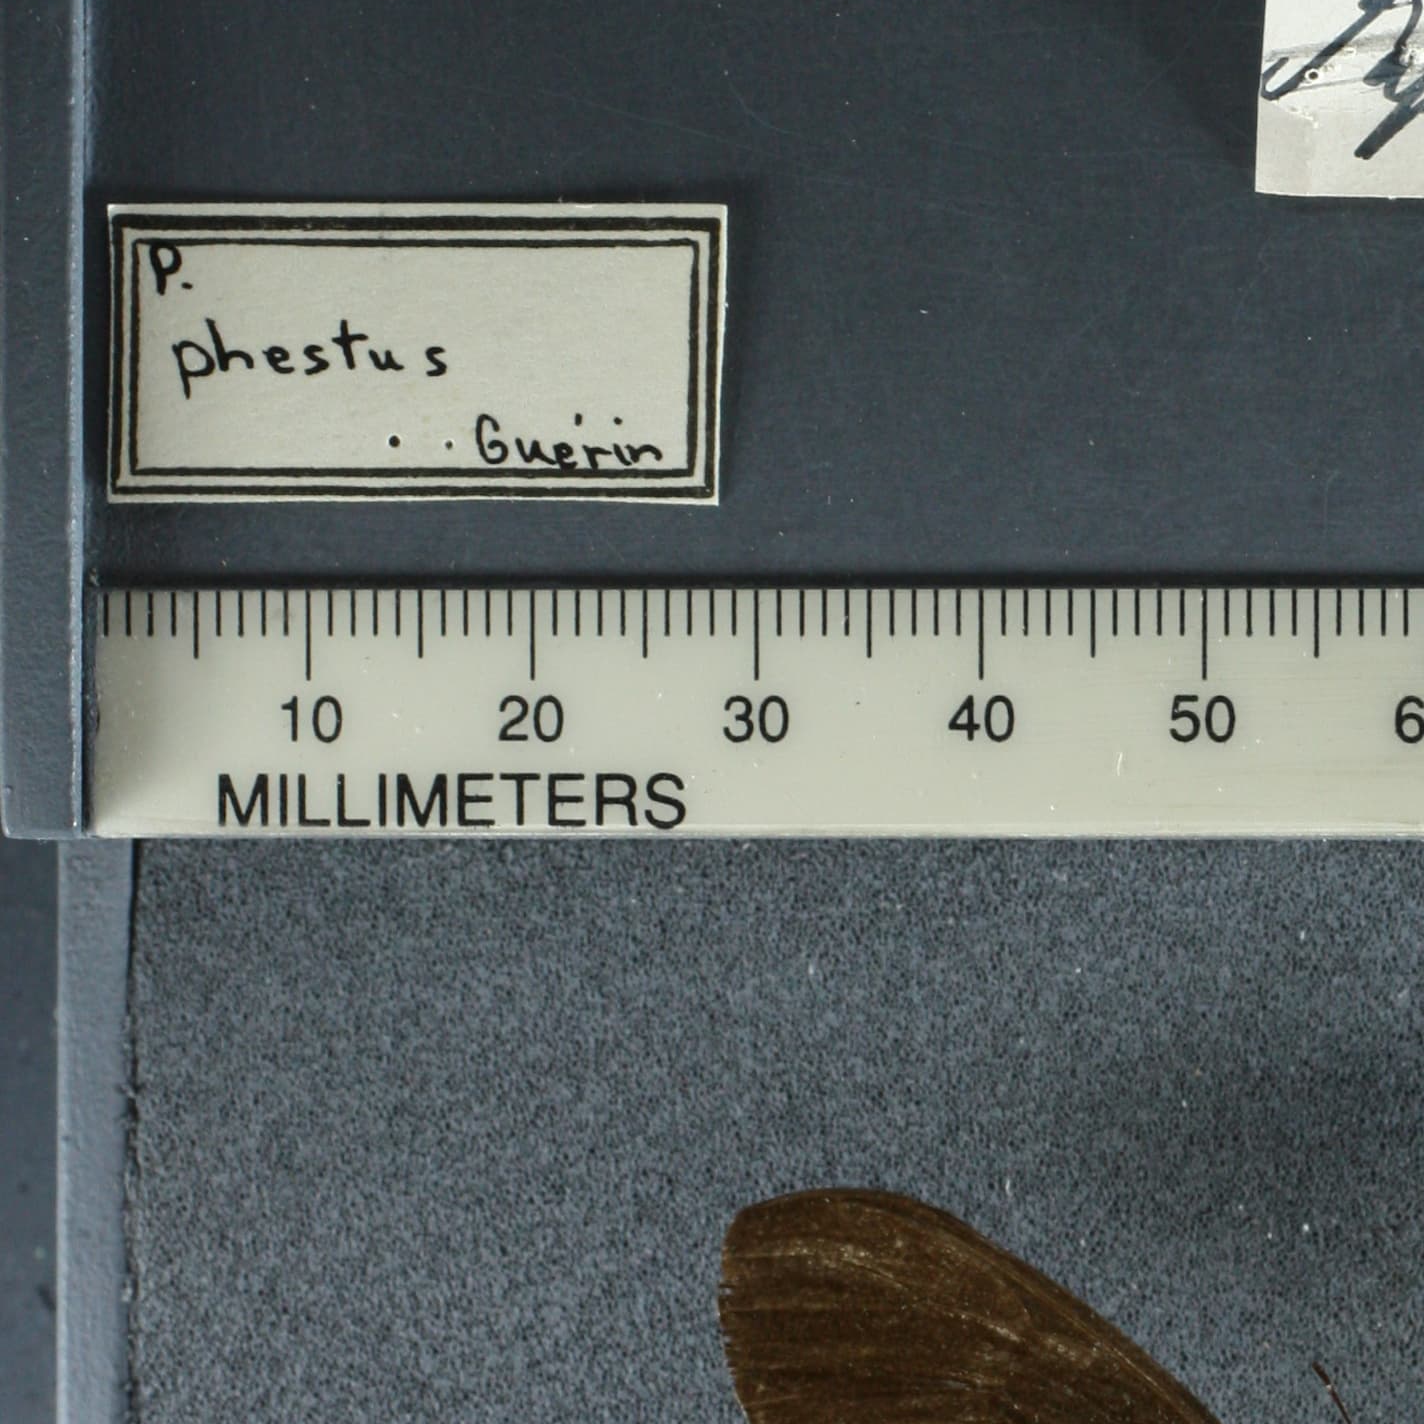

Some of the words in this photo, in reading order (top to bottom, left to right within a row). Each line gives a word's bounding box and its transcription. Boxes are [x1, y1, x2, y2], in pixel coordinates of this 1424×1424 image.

[144, 243, 197, 296] P.
[171, 317, 448, 400] phestus
[281, 695, 343, 744] 10
[498, 694, 564, 743] 20
[723, 695, 790, 743] 30
[948, 694, 1015, 743] 40
[1169, 694, 1236, 743] 50
[218, 772, 686, 830] MILLIMETERS
